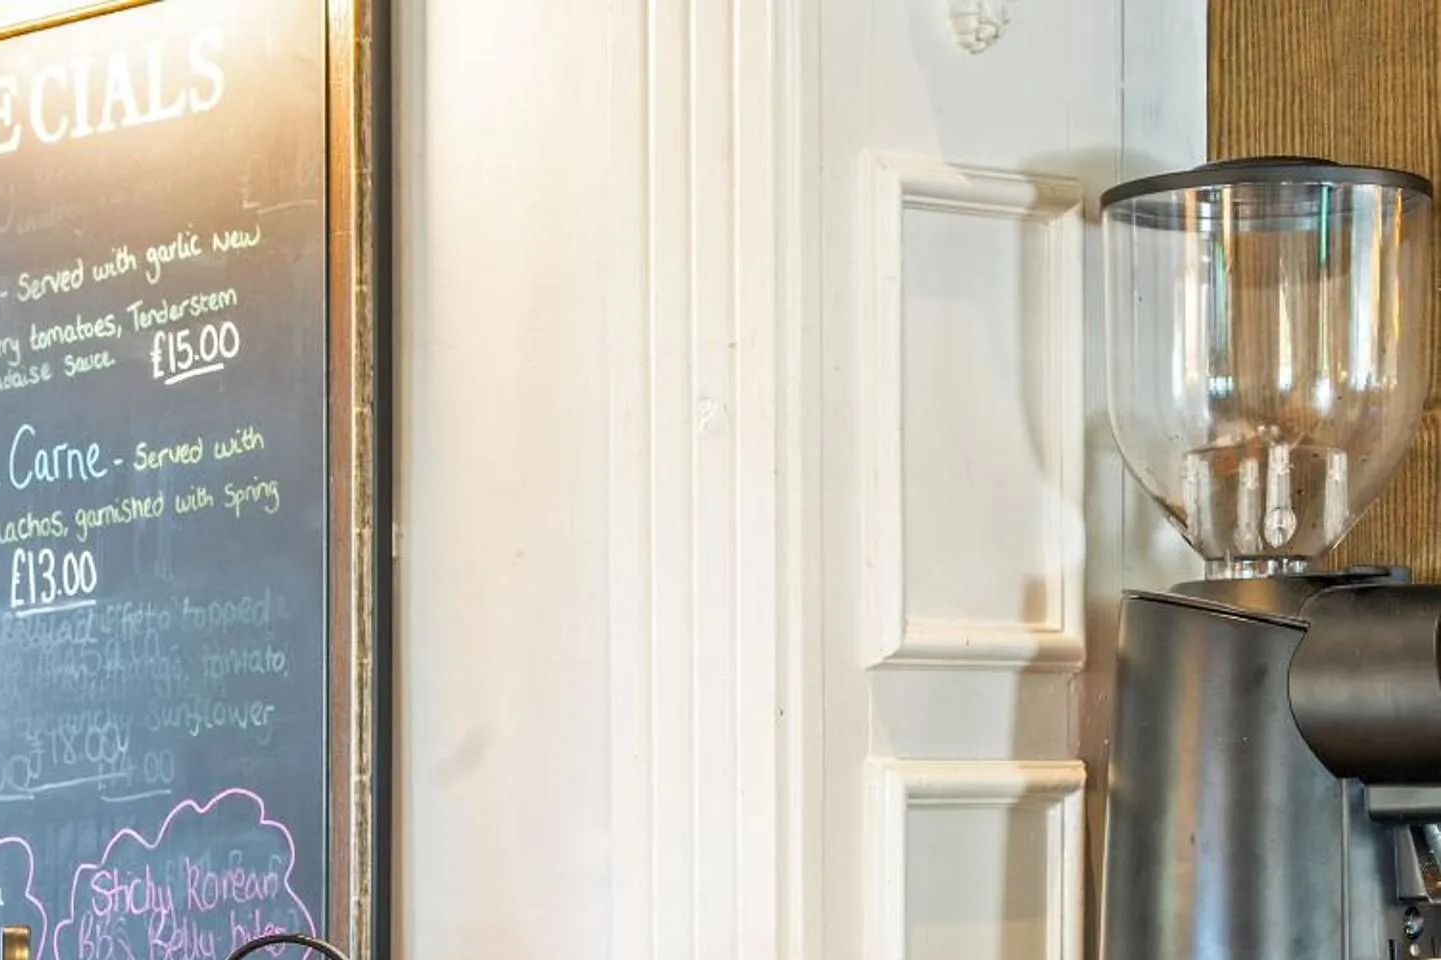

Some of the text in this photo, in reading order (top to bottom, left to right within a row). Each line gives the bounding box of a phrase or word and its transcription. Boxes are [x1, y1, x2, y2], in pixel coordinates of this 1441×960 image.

[17, 258, 84, 302] Served
[92, 245, 137, 281] with
[146, 228, 203, 284] garlic
[29, 314, 121, 350] tomatoes,
[127, 288, 237, 331] Tenderstem
[150, 320, 240, 380] £15.00
[10, 424, 108, 490] Carne
[133, 437, 203, 471] Served
[214, 425, 264, 460] with
[75, 491, 164, 542] garnished
[175, 485, 214, 514] with
[224, 476, 280, 518] Spring
[11, 547, 97, 609] £13.00
